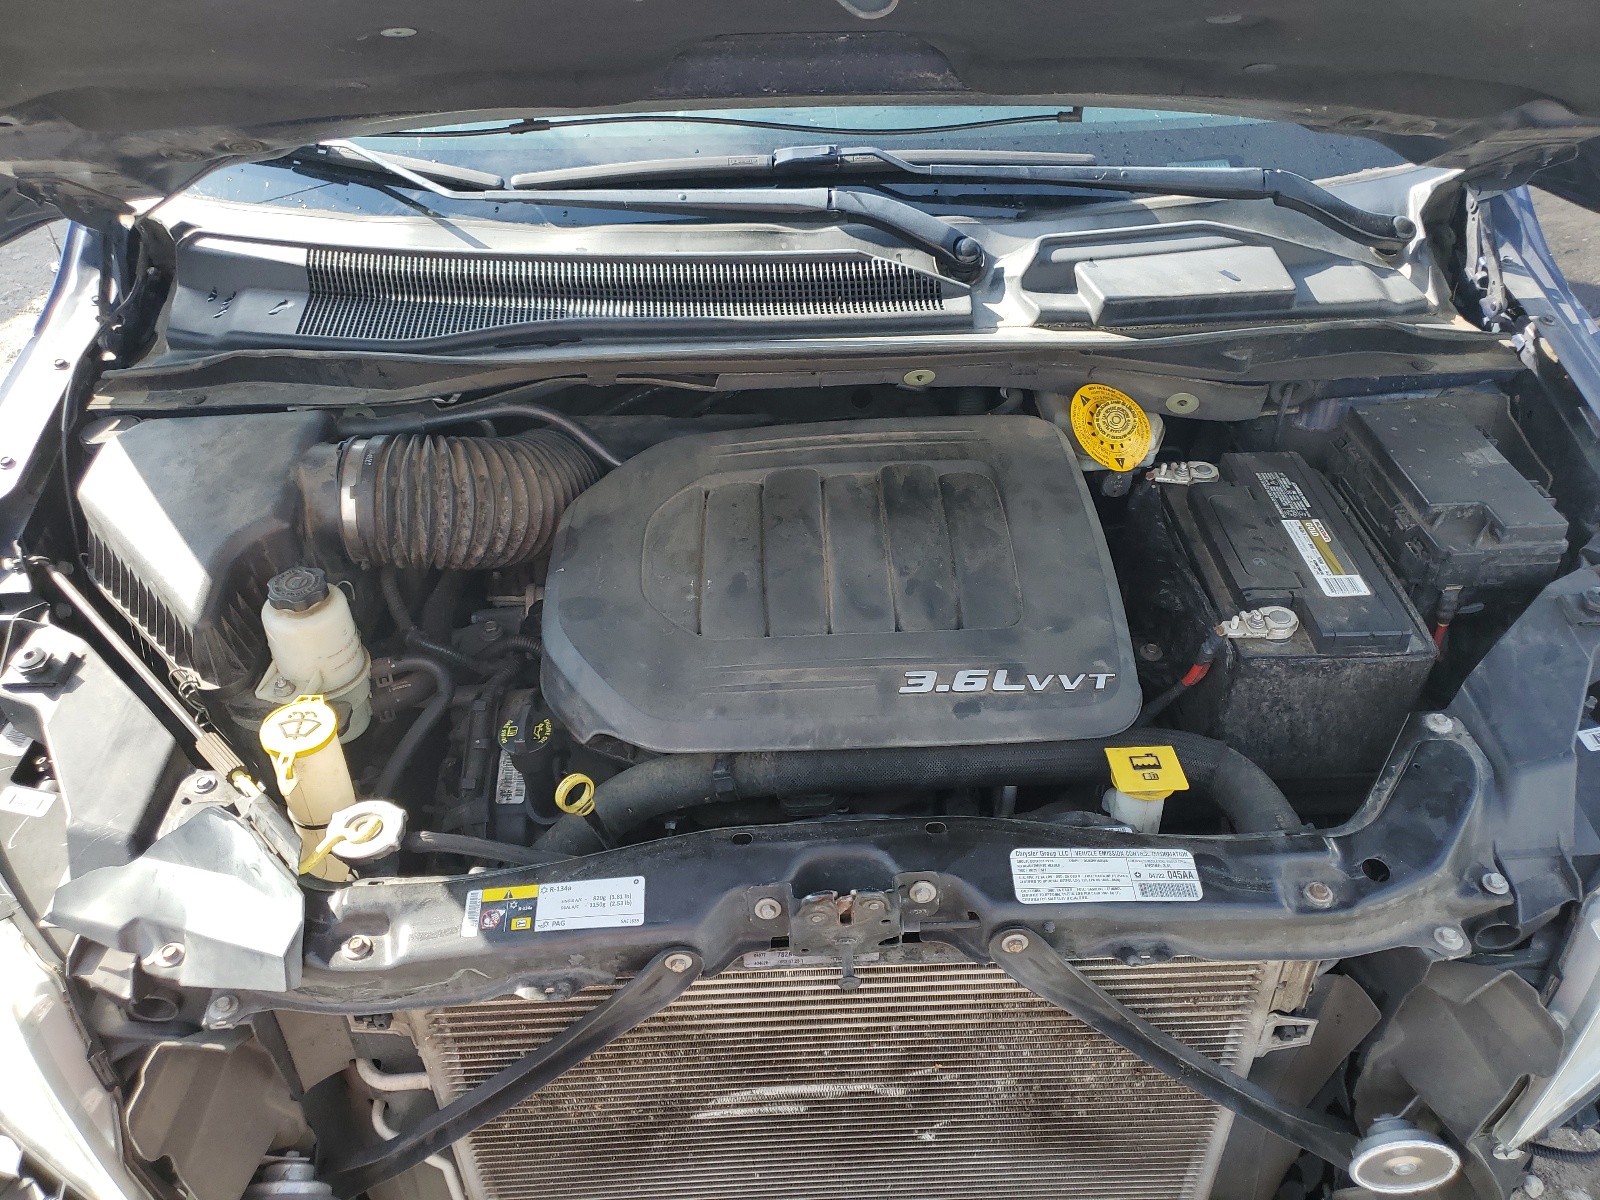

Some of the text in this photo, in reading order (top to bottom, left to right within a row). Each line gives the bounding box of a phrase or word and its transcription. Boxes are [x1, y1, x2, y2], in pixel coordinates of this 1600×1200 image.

[1305, 522, 1319, 537] GOLD
[543, 718, 552, 736] ENGINE
[1015, 850, 1039, 858] Chrysler
[1039, 850, 1057, 858] Group
[1167, 870, 1195, 880] 045AA
[549, 885, 572, 893] R-134a
